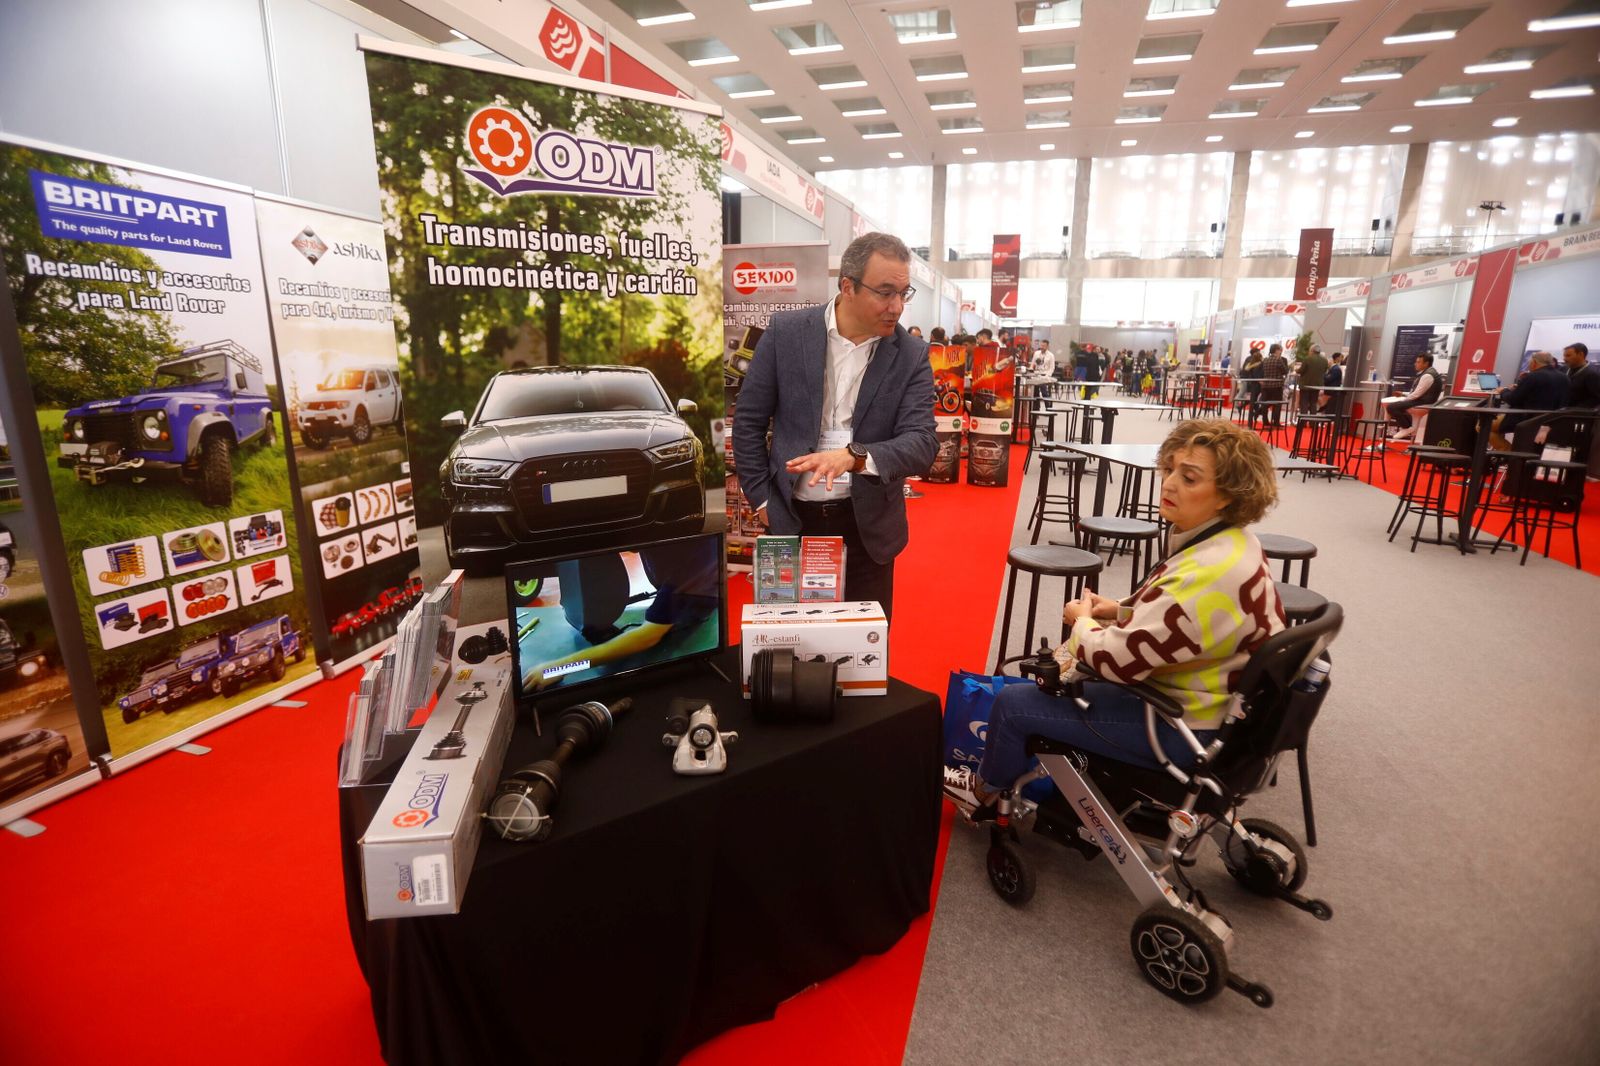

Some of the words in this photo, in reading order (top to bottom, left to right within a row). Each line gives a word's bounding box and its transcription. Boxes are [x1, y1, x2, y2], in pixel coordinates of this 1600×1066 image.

[535, 131, 655, 191] ODM
[42, 180, 218, 228] BRITPART
[52, 219, 77, 232] The
[79, 225, 119, 239] quality
[121, 230, 148, 242] parts
[150, 232, 165, 243] for
[167, 235, 191, 247] Land
[193, 239, 223, 251] Rovers
[418, 213, 614, 260] Transmisiones,
[618, 230, 699, 265] fuelles,
[1563, 234, 1587, 247] BRAIN
[1309, 240, 1321, 266] Peña
[25, 253, 142, 285] Recambios
[146, 269, 157, 289] y
[163, 271, 252, 293] accesorios
[427, 257, 600, 292] homocinética
[606, 271, 619, 298] y
[625, 269, 698, 296] cardán
[736, 268, 794, 285] SEKIDO
[1305, 266, 1319, 296] Grupo
[76, 291, 125, 311] para
[129, 290, 173, 312] Land
[177, 293, 226, 314] Rover
[278, 277, 340, 299] Recambios
[342, 287, 350, 302] y
[281, 303, 310, 320] para
[313, 301, 337, 320] 4x4,
[338, 304, 376, 320] turismo
[378, 308, 386, 323] y
[761, 303, 768, 313] y
[740, 315, 759, 328] 4x4,
[543, 659, 589, 674] BRITPART
[407, 773, 447, 810] ODM
[1078, 797, 1120, 849] Libercar
[398, 864, 411, 890] ODM
